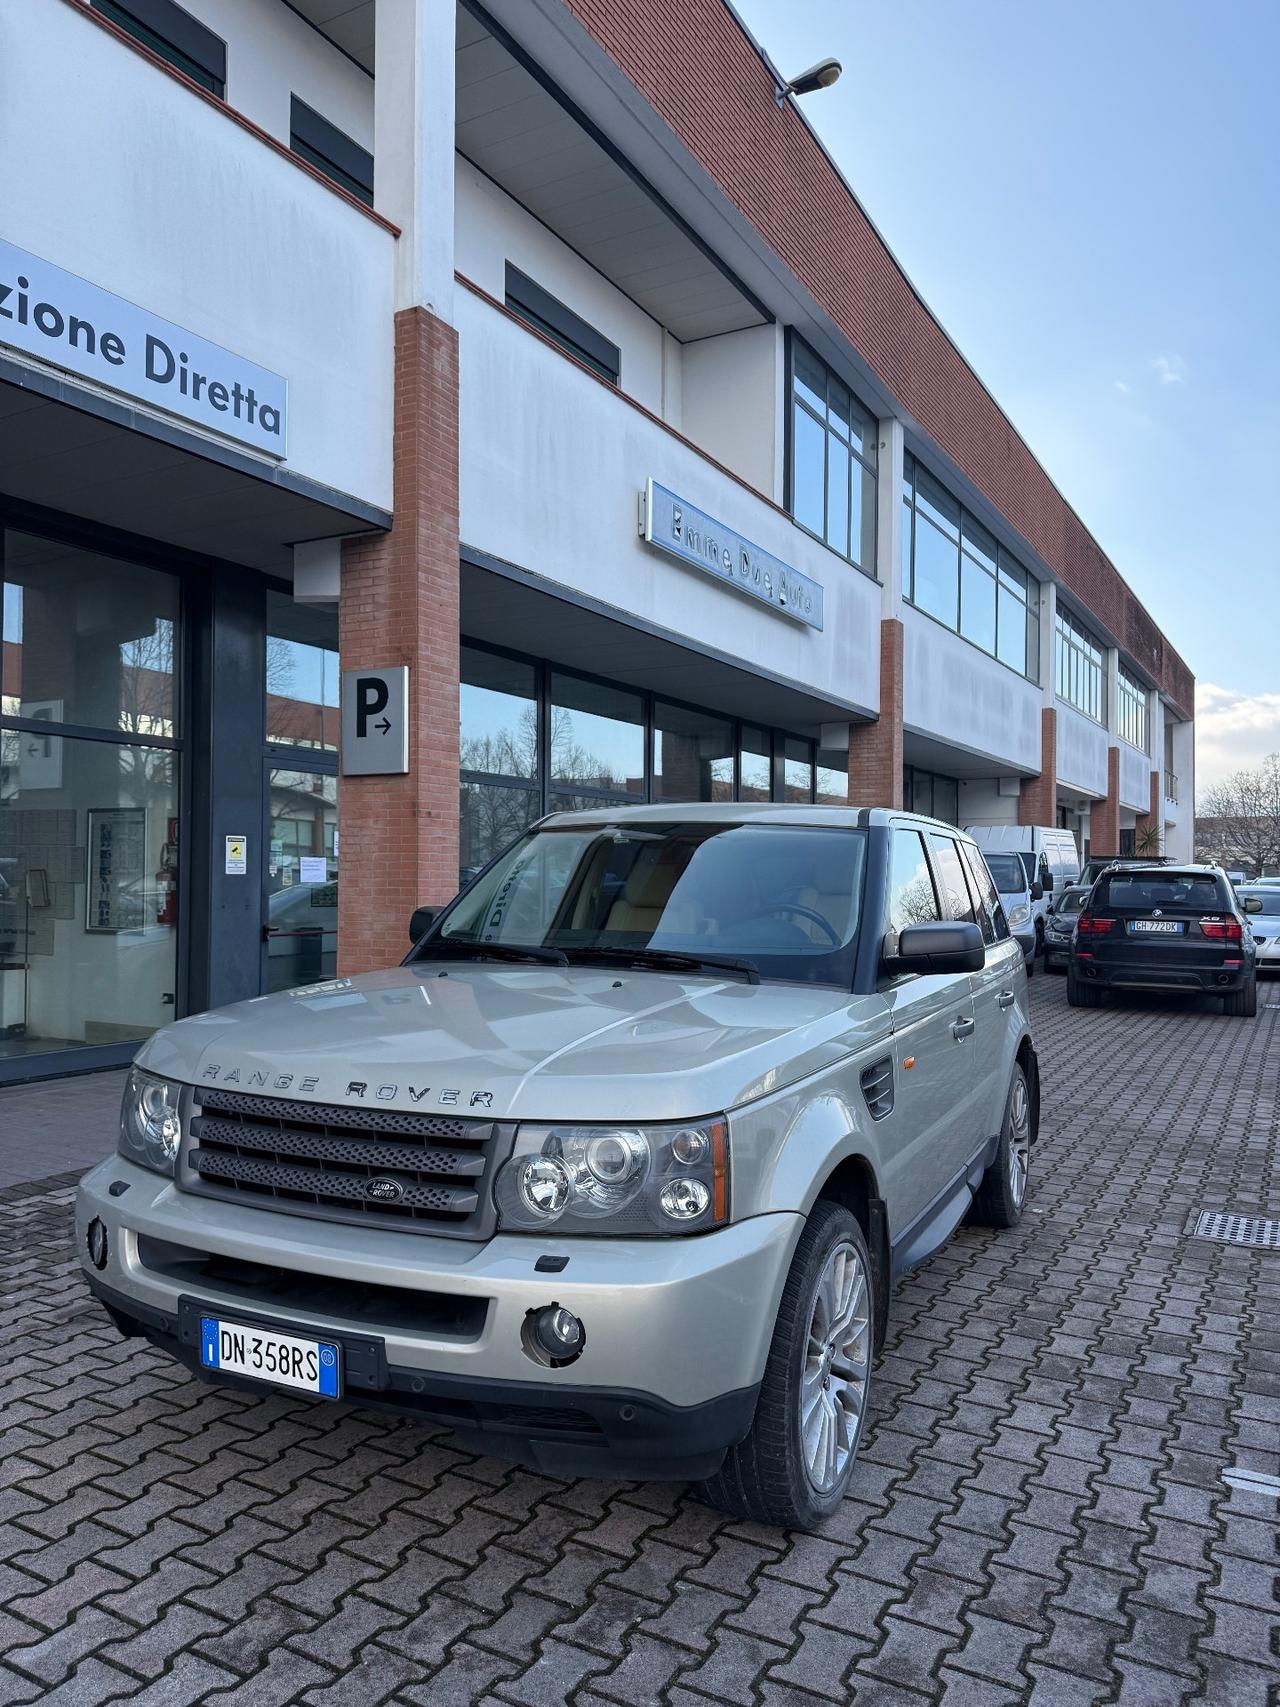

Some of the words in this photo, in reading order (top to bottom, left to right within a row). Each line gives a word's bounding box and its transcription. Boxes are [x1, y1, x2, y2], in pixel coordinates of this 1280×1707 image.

[145, 333, 280, 436] Diretta
[672, 503, 732, 574] Emme
[740, 544, 773, 596] Due
[779, 570, 813, 614] Auto
[357, 677, 389, 738] P
[202, 1064, 319, 1092] RANGE
[345, 1081, 494, 1108] ROVER
[221, 1330, 246, 1365] DN
[252, 1337, 319, 1382] 358RS
